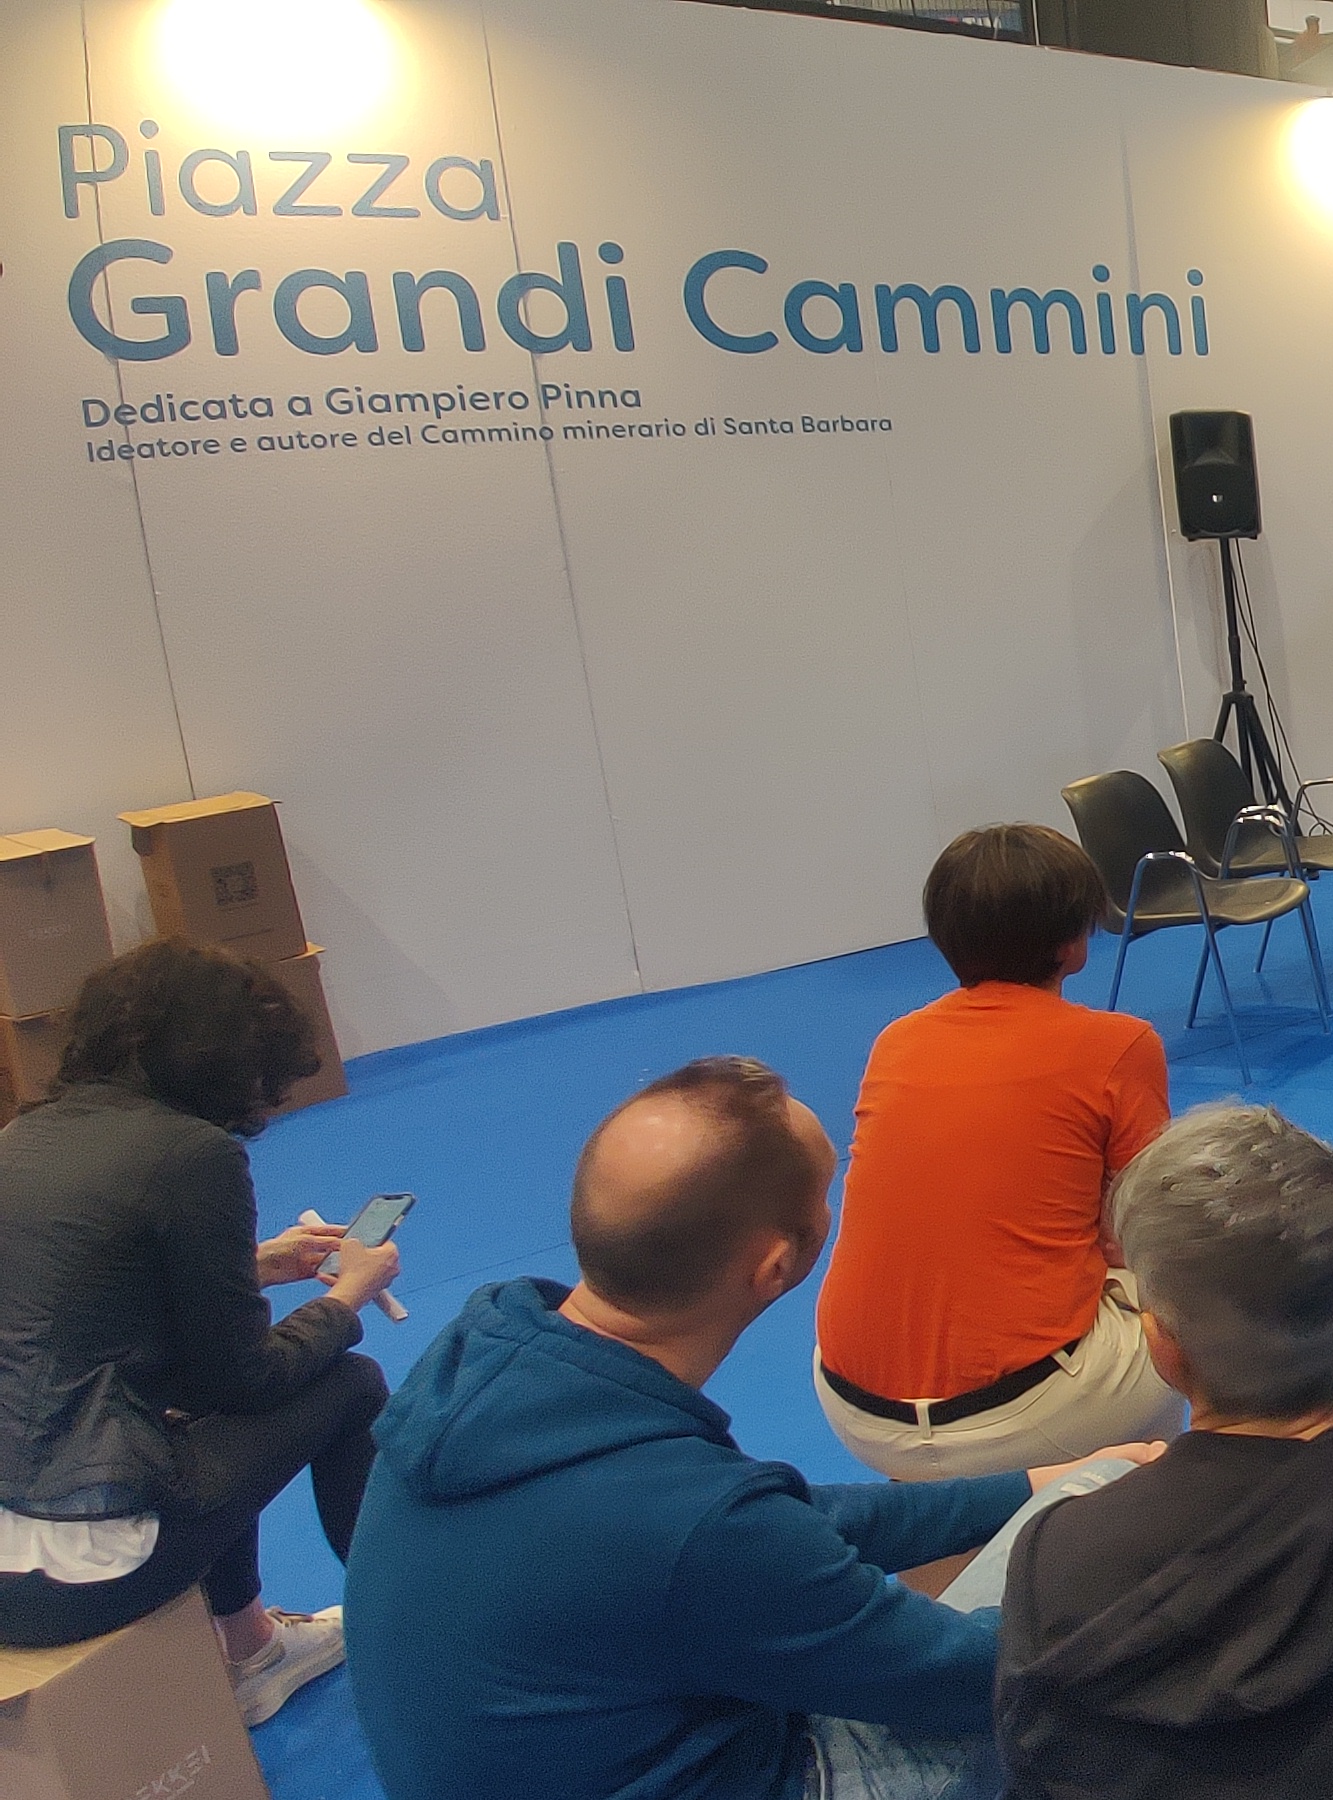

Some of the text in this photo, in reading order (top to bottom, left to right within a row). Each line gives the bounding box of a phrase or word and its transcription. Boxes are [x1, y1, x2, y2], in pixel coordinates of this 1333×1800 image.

[58, 119, 505, 221] Piazza
[67, 240, 1210, 363] Grandi Cammini
[81, 383, 642, 428] Dedicata a Giampiero Pinna
[87, 415, 893, 462] Ideatore e autore del Cammino minerario di Santa Barbara
